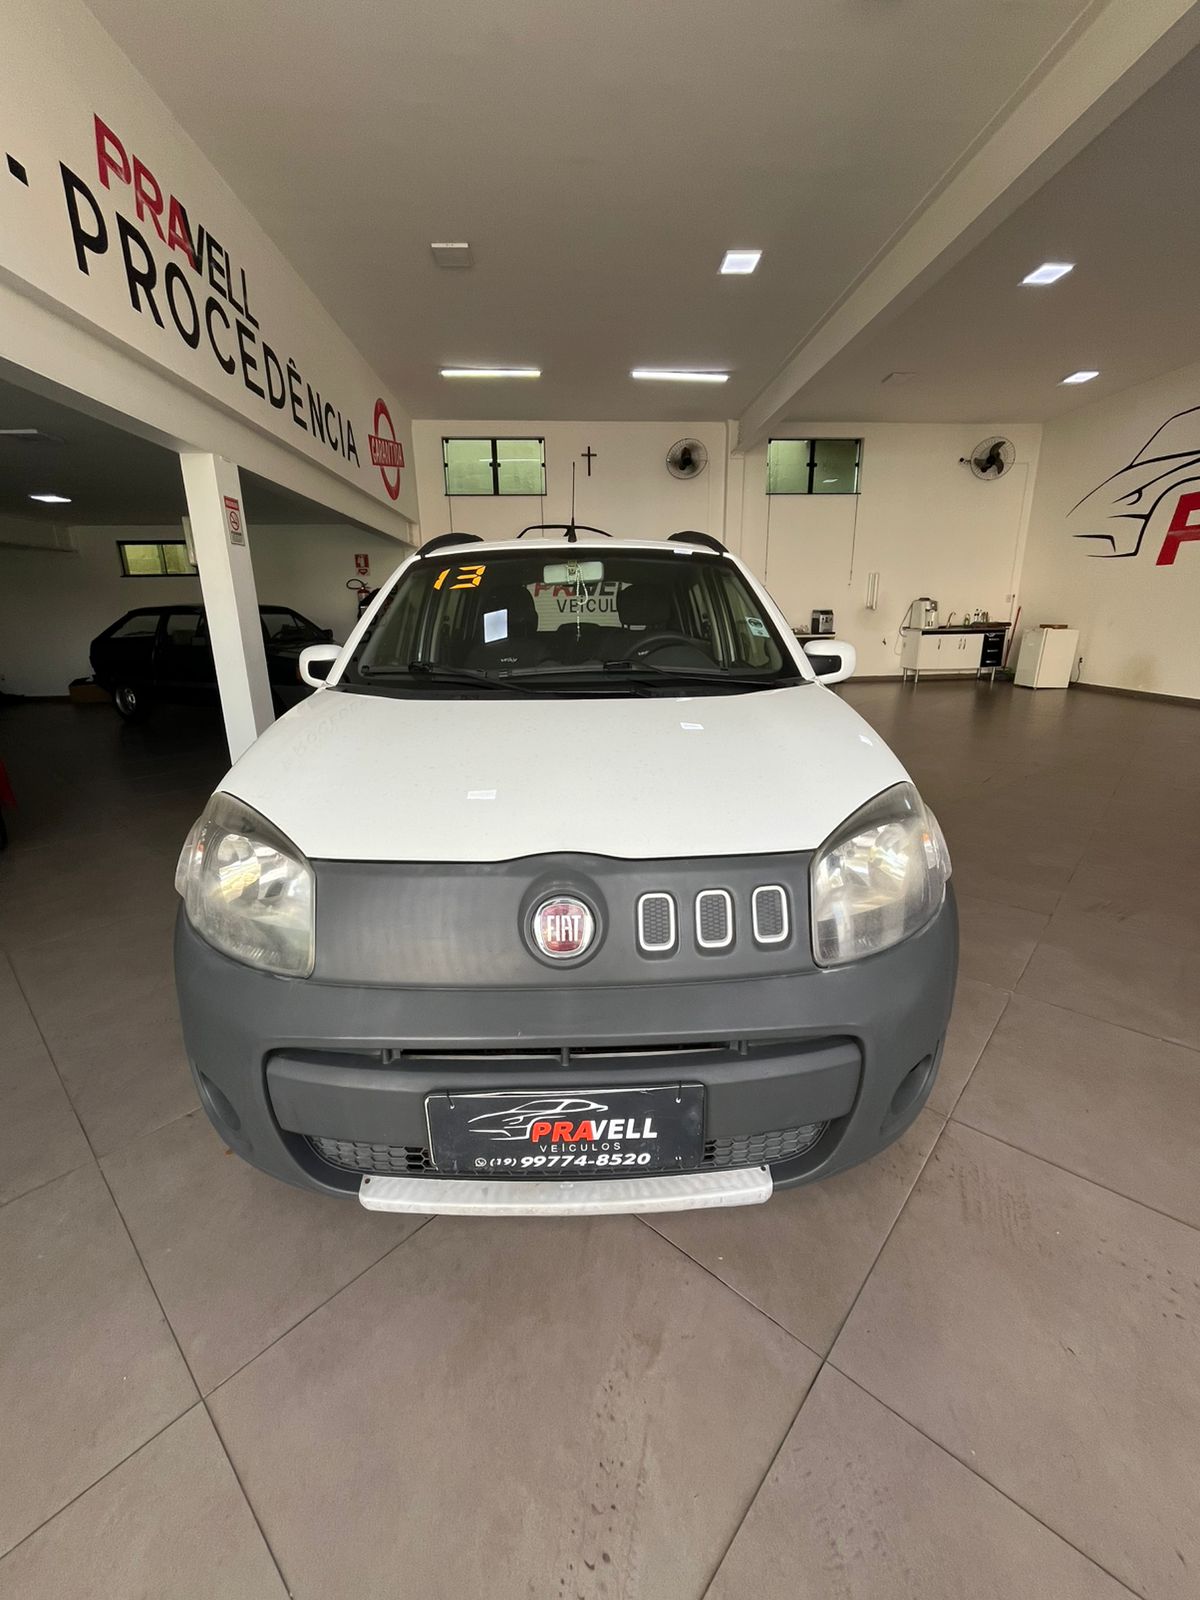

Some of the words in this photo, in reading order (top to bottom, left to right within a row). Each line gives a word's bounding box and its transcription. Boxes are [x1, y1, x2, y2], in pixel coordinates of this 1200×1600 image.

[94, 113, 259, 329] PRAVELL
[59, 160, 360, 468] PROCEDÊNCIA
[433, 565, 486, 590] 13
[546, 914, 582, 942] FIAT
[531, 1118, 658, 1143] PRAVELL
[489, 1158, 517, 1167] (19)
[520, 1153, 651, 1168] 99774-8520
